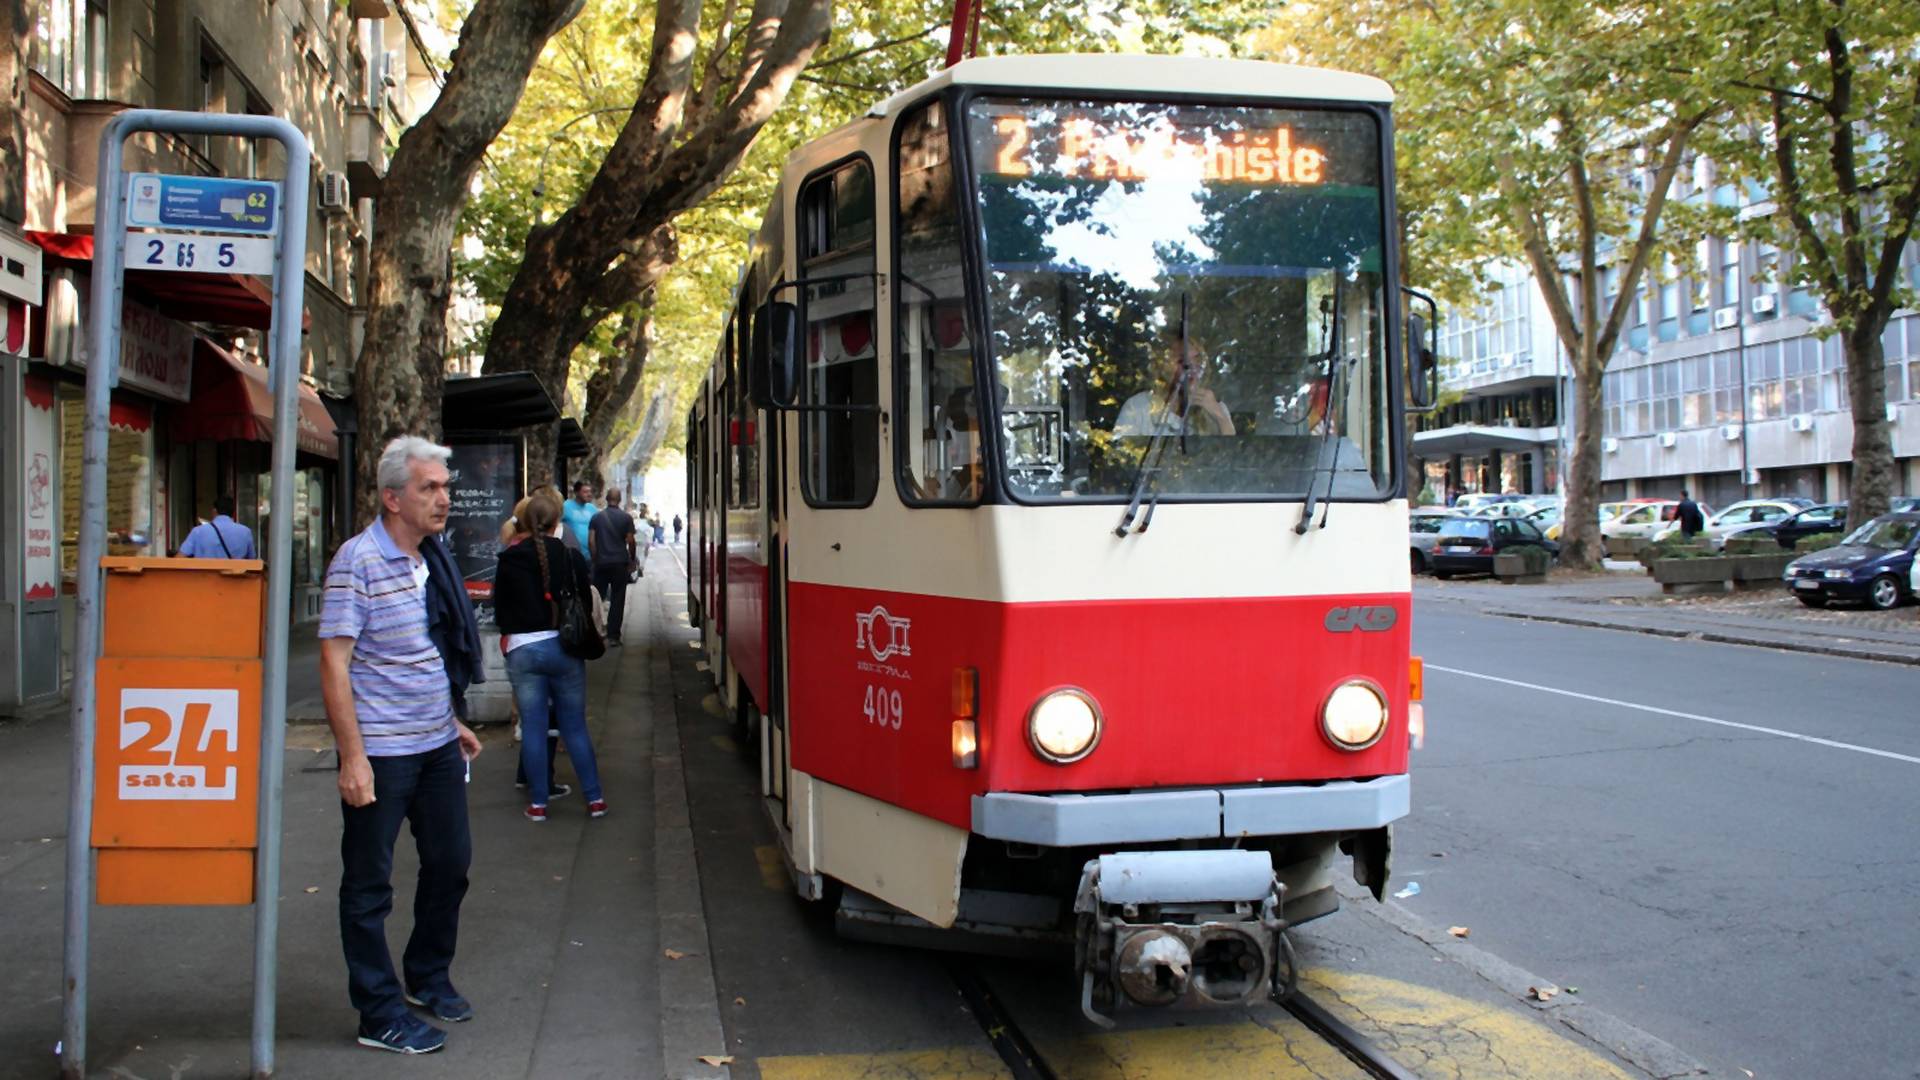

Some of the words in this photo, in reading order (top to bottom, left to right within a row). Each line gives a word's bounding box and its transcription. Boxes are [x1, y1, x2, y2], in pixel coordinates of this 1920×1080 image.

[997, 117, 1029, 175] 2
[1062, 118, 1323, 184] Pnište
[247, 192, 268, 209] 62
[146, 239, 165, 265] 2
[218, 243, 236, 267] 5
[863, 684, 903, 731] 409
[119, 702, 239, 788] 24
[126, 771, 196, 788] sata
